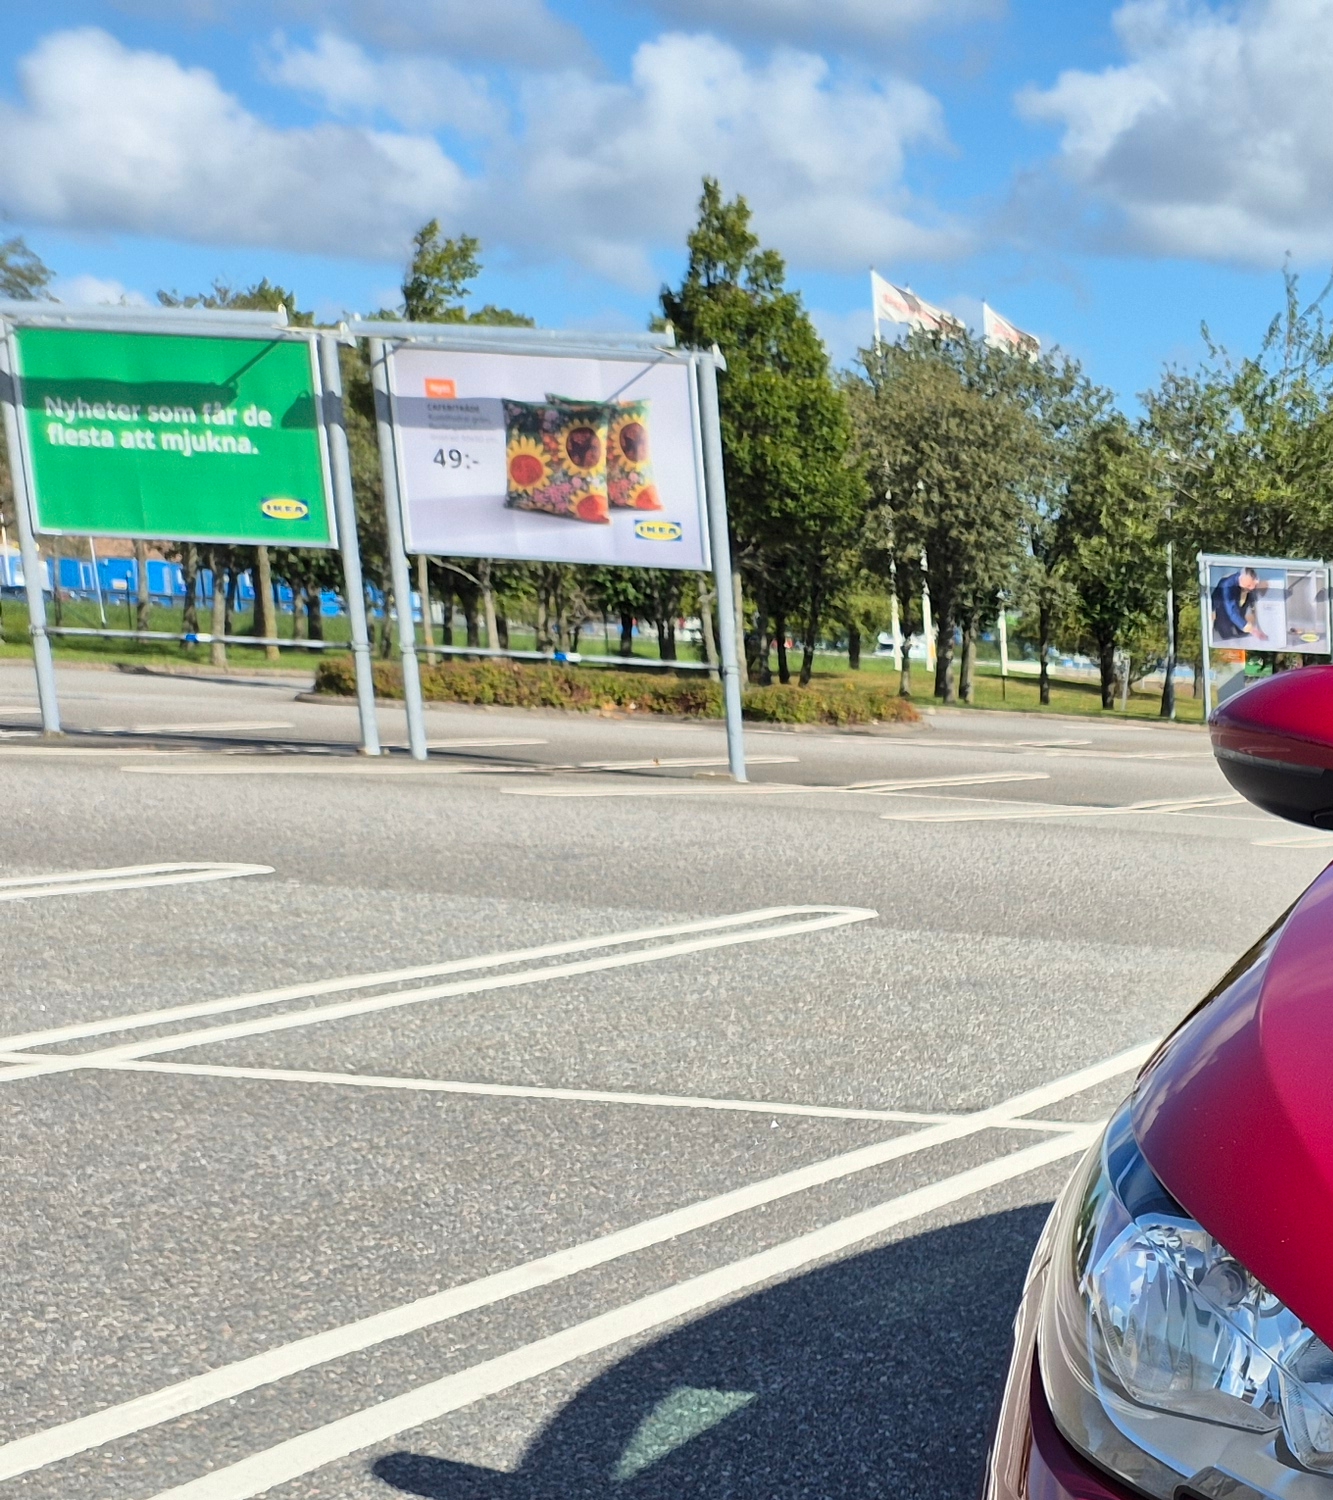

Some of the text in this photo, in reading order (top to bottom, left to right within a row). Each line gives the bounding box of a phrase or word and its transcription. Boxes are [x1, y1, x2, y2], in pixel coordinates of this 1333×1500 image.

[44, 397, 272, 428] Nyheter som får de
[48, 422, 259, 457] flesta att mjukna.
[265, 502, 305, 515] IKEA
[640, 525, 679, 537] IKEA
